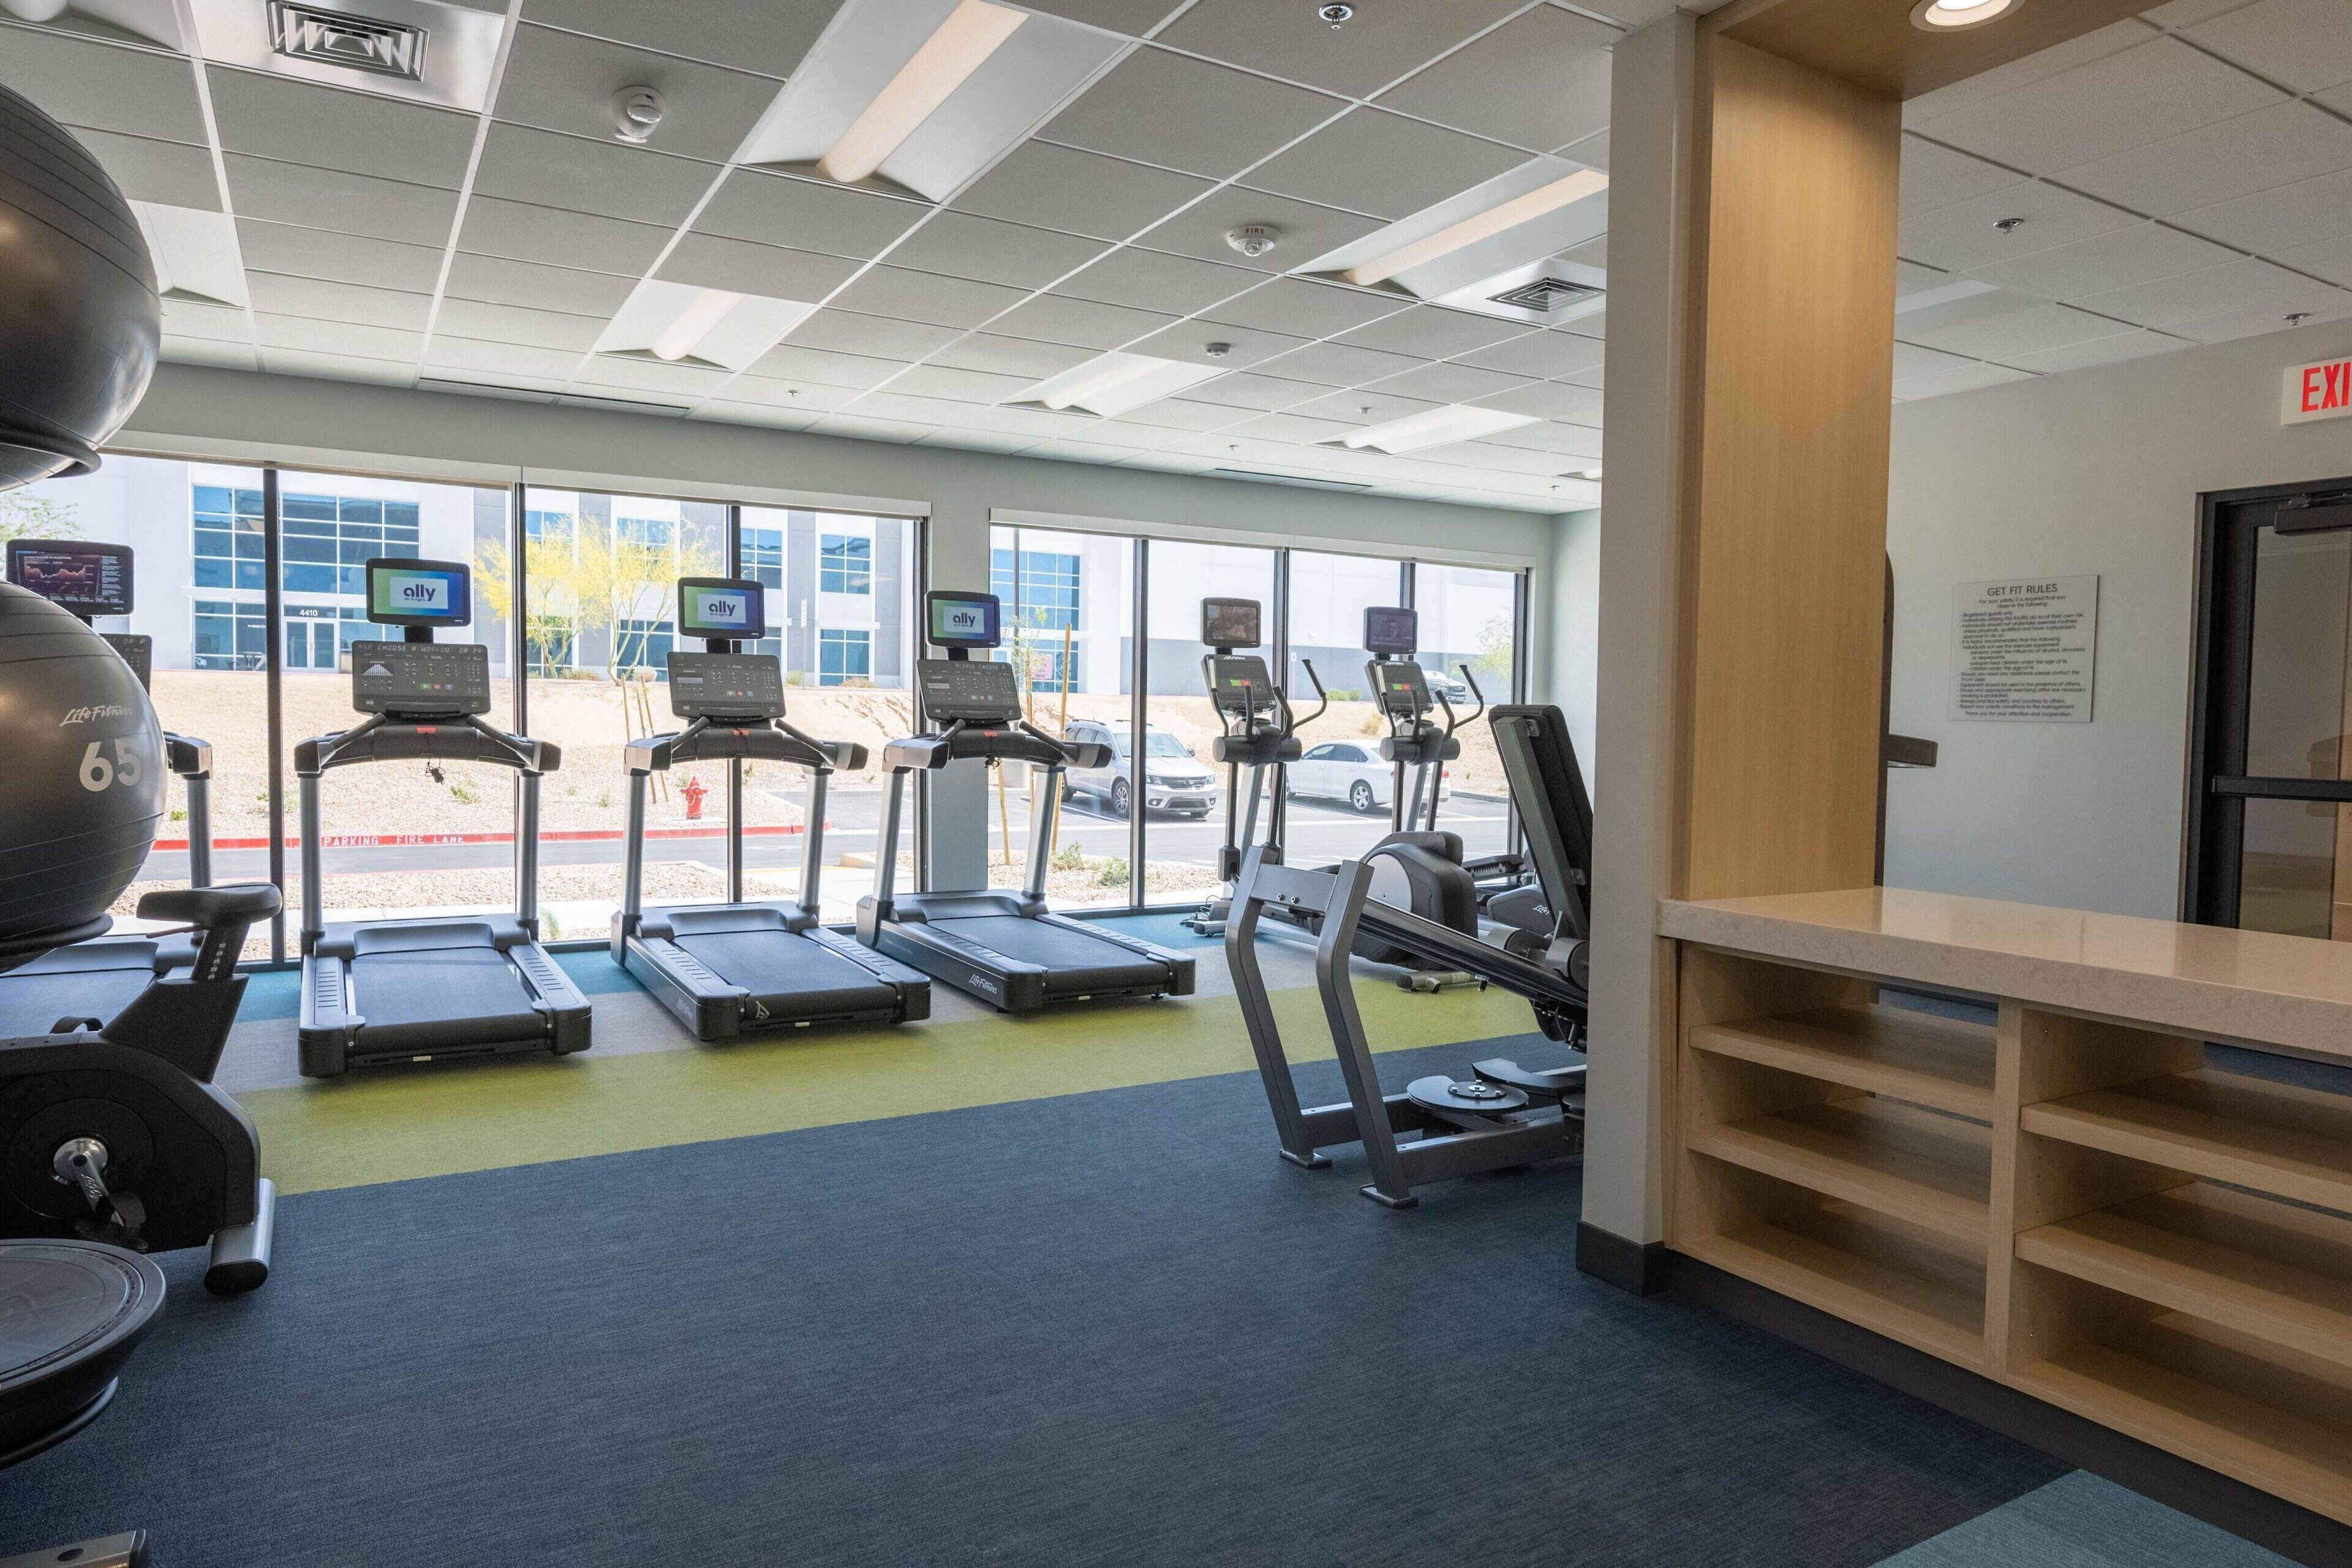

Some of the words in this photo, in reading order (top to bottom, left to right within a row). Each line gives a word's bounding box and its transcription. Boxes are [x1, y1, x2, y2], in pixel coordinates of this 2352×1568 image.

[404, 584, 436, 601] ally
[1987, 587, 2006, 596] GET
[2010, 586, 2022, 594] FIT
[2026, 584, 2057, 594] RULES
[709, 600, 736, 616] ally
[953, 612, 976, 627] ally
[59, 707, 91, 727] Life
[79, 737, 141, 791] 65
[323, 836, 379, 846] PARKING
[396, 834, 424, 844] FIRE
[434, 834, 464, 843] LANE
